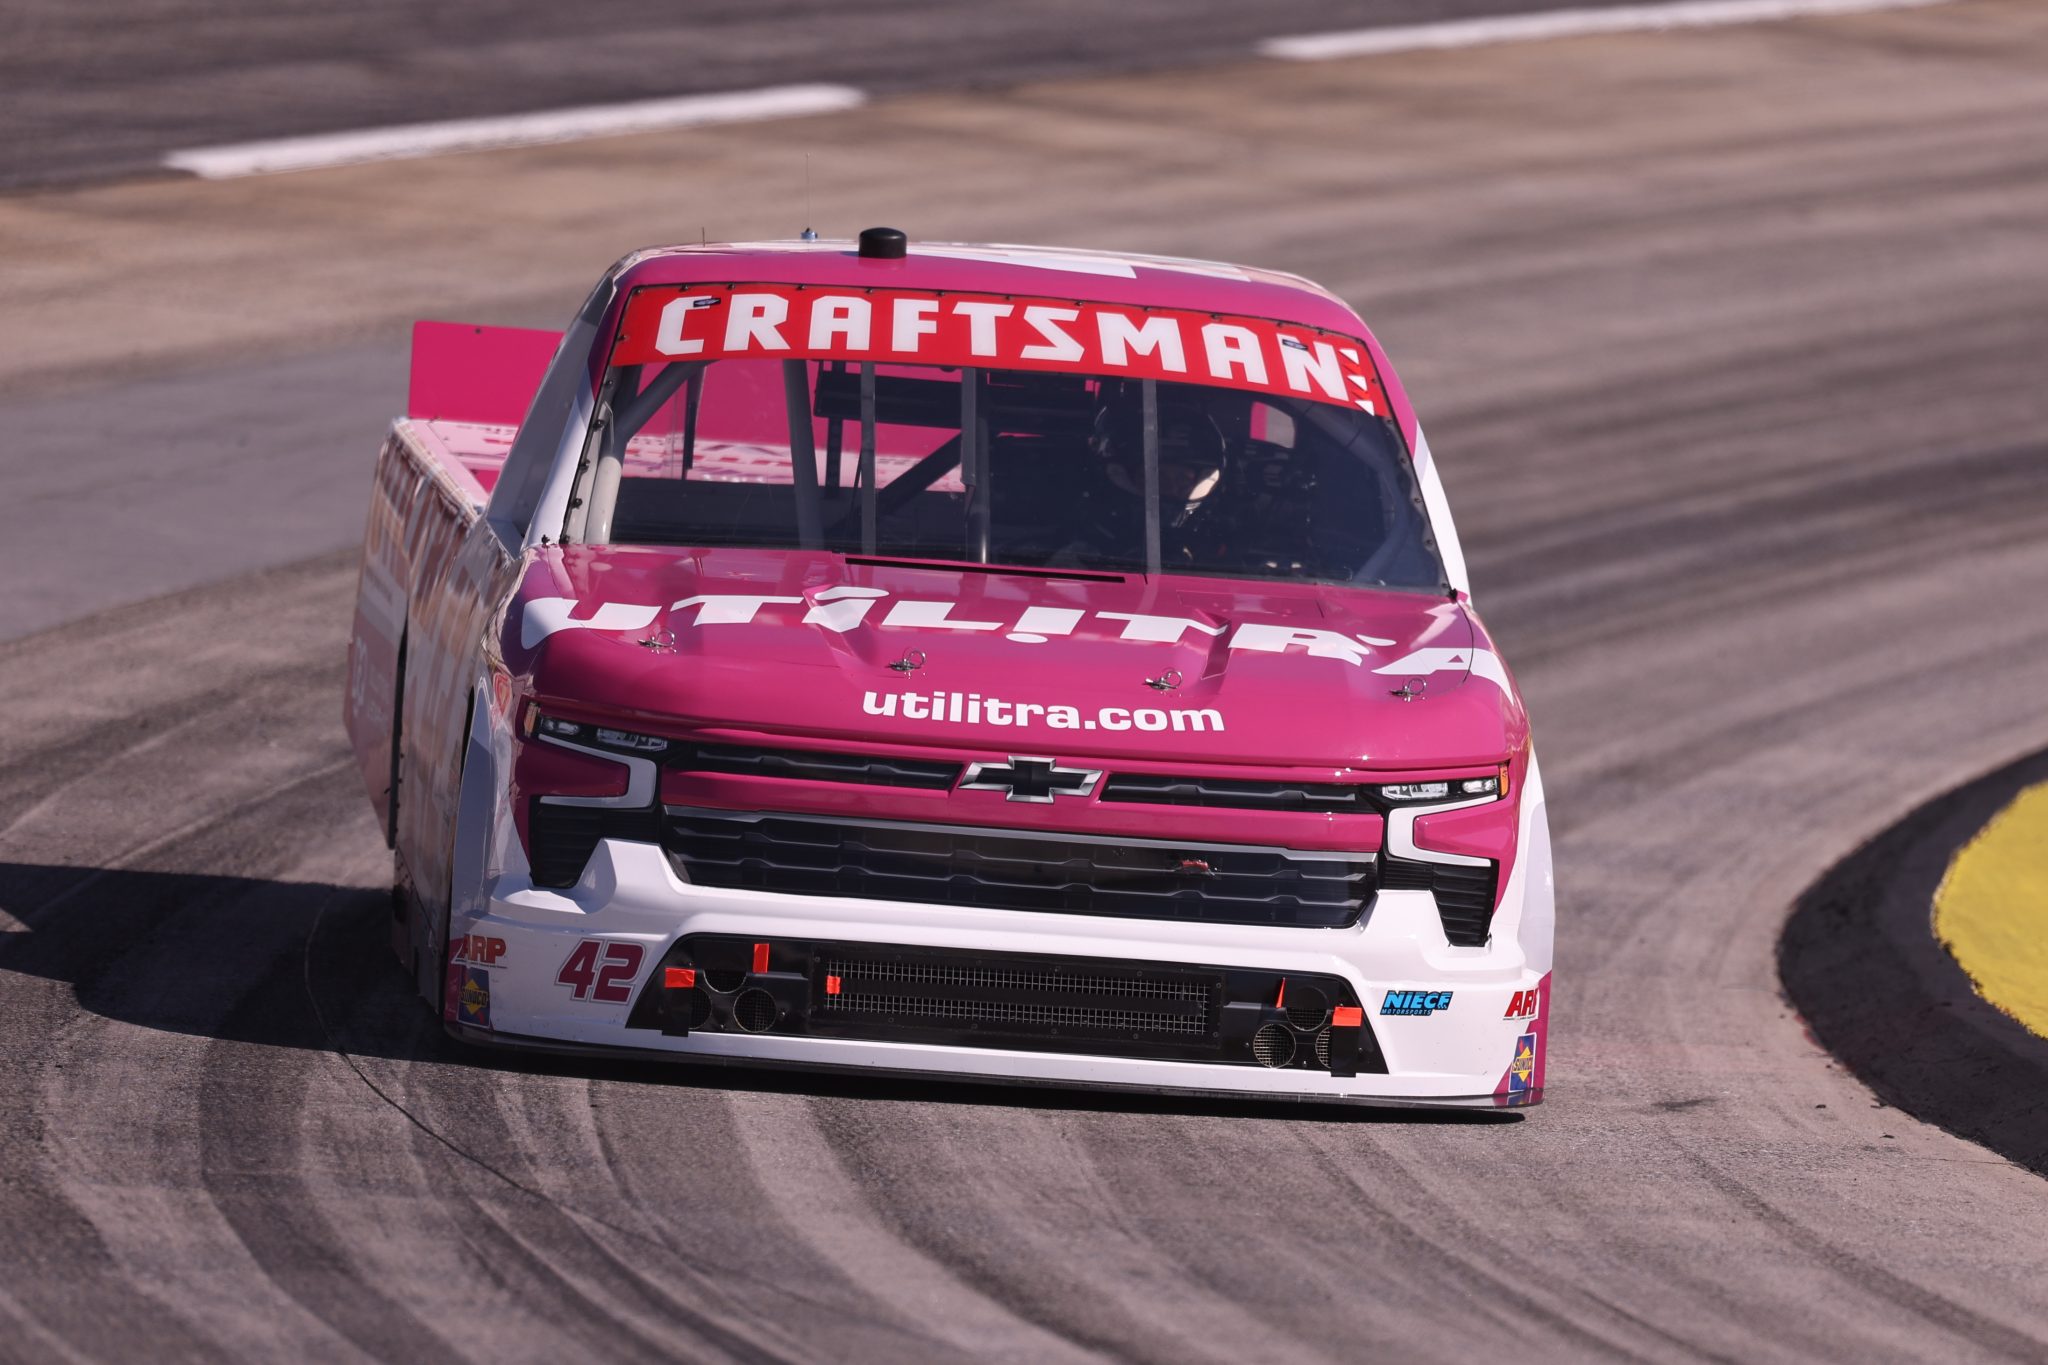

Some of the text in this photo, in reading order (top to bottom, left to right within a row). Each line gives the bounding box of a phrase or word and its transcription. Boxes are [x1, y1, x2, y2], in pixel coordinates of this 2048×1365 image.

[655, 293, 1349, 402] CRAFTSMAN
[863, 691, 1225, 732] utilitra.com
[451, 933, 507, 964] ARP
[554, 937, 646, 1005] 42
